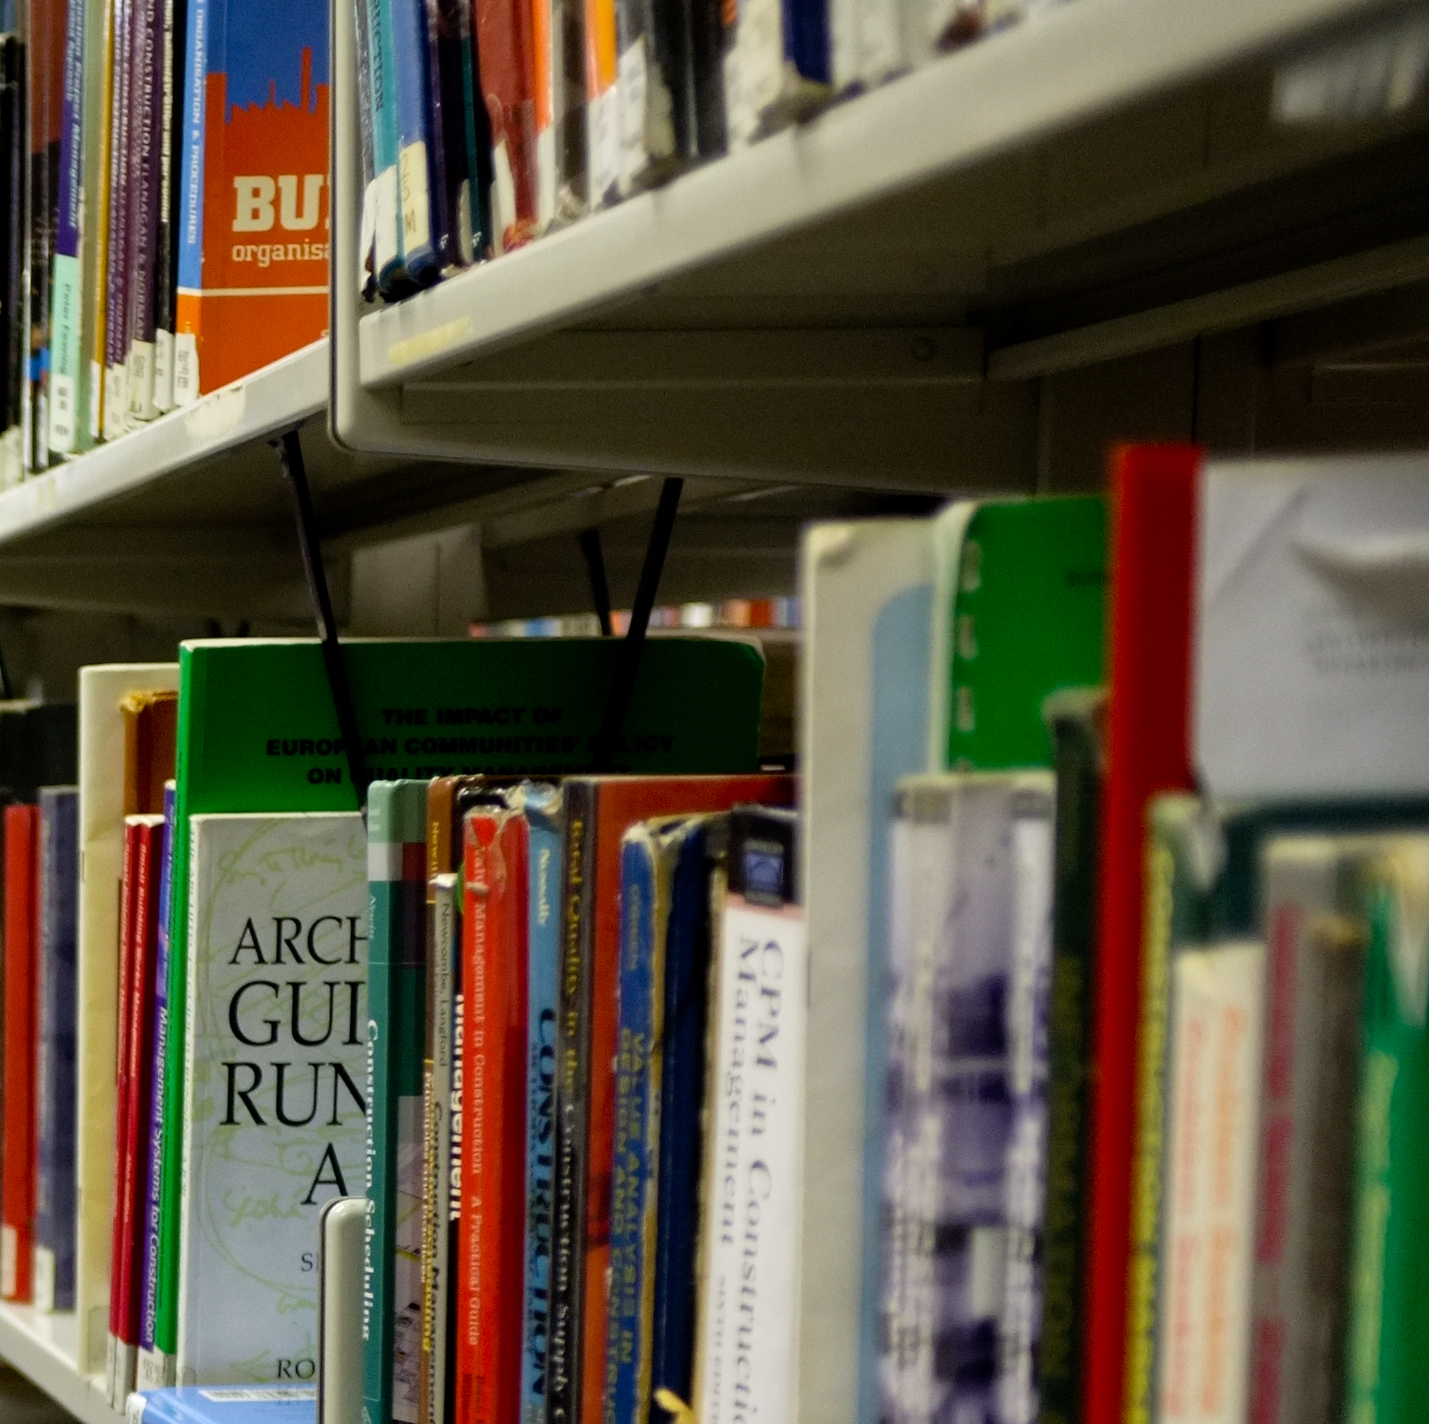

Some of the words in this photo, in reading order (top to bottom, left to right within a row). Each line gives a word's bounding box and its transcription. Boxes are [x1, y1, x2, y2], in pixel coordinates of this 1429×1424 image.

[141, 33, 155, 157] CONSTRUCTION
[139, 162, 151, 250] FLANAGAN
[231, 173, 330, 233] BU
[231, 238, 330, 268] organis
[136, 270, 148, 341] NORMAN
[266, 737, 397, 757] EUROPAN
[381, 708, 428, 726] THE
[435, 707, 526, 725] IMPACT
[532, 706, 564, 725] OF
[307, 767, 341, 785] ON
[568, 818, 585, 885] Total
[438, 901, 452, 995] Newcombe,
[472, 902, 489, 1025] Management
[565, 895, 585, 995] Quality
[436, 999, 450, 1067] Langford
[473, 1030, 488, 1047] in
[754, 940, 786, 1070] CPM
[153, 1007, 168, 1128] Management
[364, 1018, 379, 1189] Construction
[563, 1049, 581, 1094] the
[614, 1028, 634, 1156] DESIGN
[628, 1032, 646, 1140] VALUE
[719, 935, 760, 1247] Management
[471, 1053, 488, 1176] Construction
[751, 1092, 777, 1136] in
[149, 1128, 165, 1200] Systems
[531, 1007, 557, 1396] CONSTRUCTION
[556, 1104, 579, 1293] Construction
[610, 1167, 629, 1235] AND
[149, 1204, 161, 1230] for
[468, 1210, 485, 1290] Practical
[621, 1152, 641, 1318] ANALYSIS
[144, 1233, 160, 1343] Construction
[360, 1198, 377, 1341] Scheduling
[467, 1296, 483, 1345] Guide
[551, 1301, 571, 1392] Supply
[619, 1331, 635, 1365] IN
